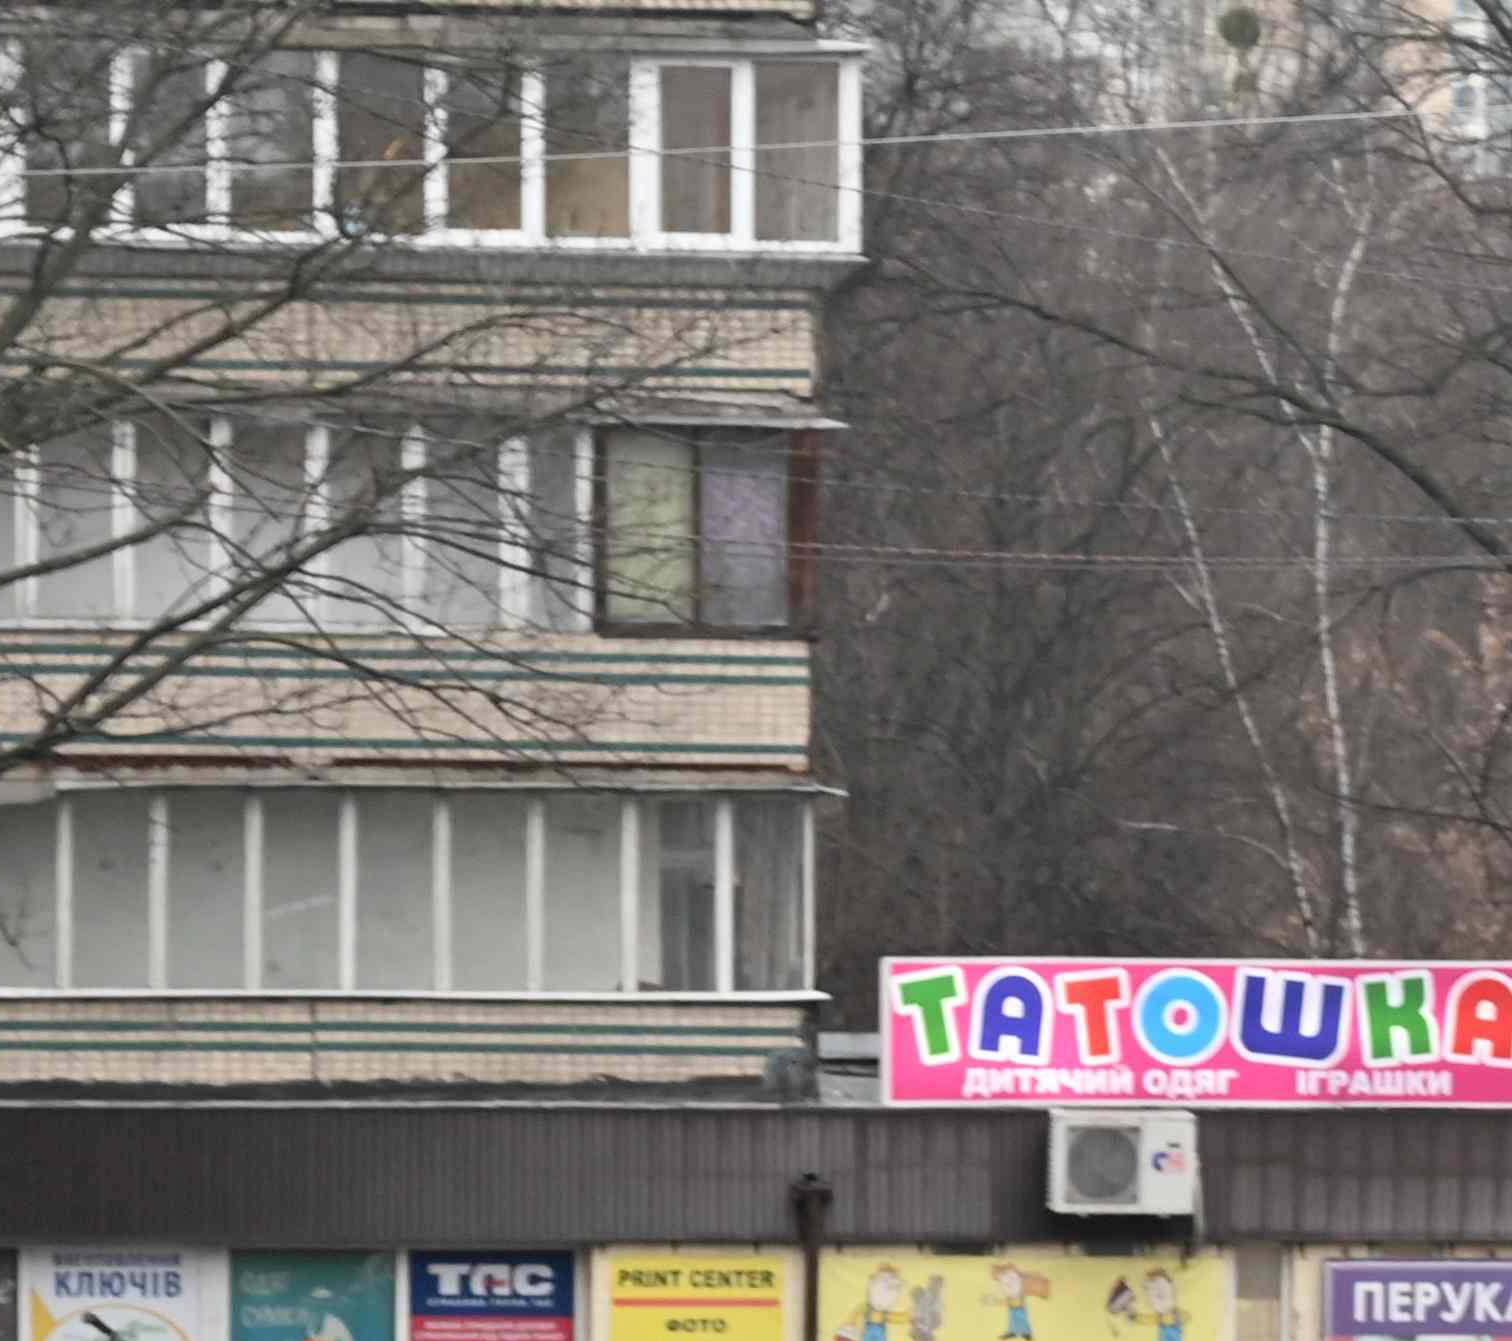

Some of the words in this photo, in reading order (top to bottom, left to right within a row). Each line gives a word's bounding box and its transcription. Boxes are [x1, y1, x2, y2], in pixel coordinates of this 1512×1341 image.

[964, 1064, 1135, 1099] ДИТЯЧИЙ
[1142, 1070, 1240, 1099] ОДЯГ
[1295, 1069, 1453, 1098] ІГРАШКИ
[55, 1270, 183, 1298] КЛЮЧІВ
[618, 1269, 682, 1288] PRINT
[690, 1269, 776, 1289] CENTER
[665, 1319, 728, 1333] ФОТО
